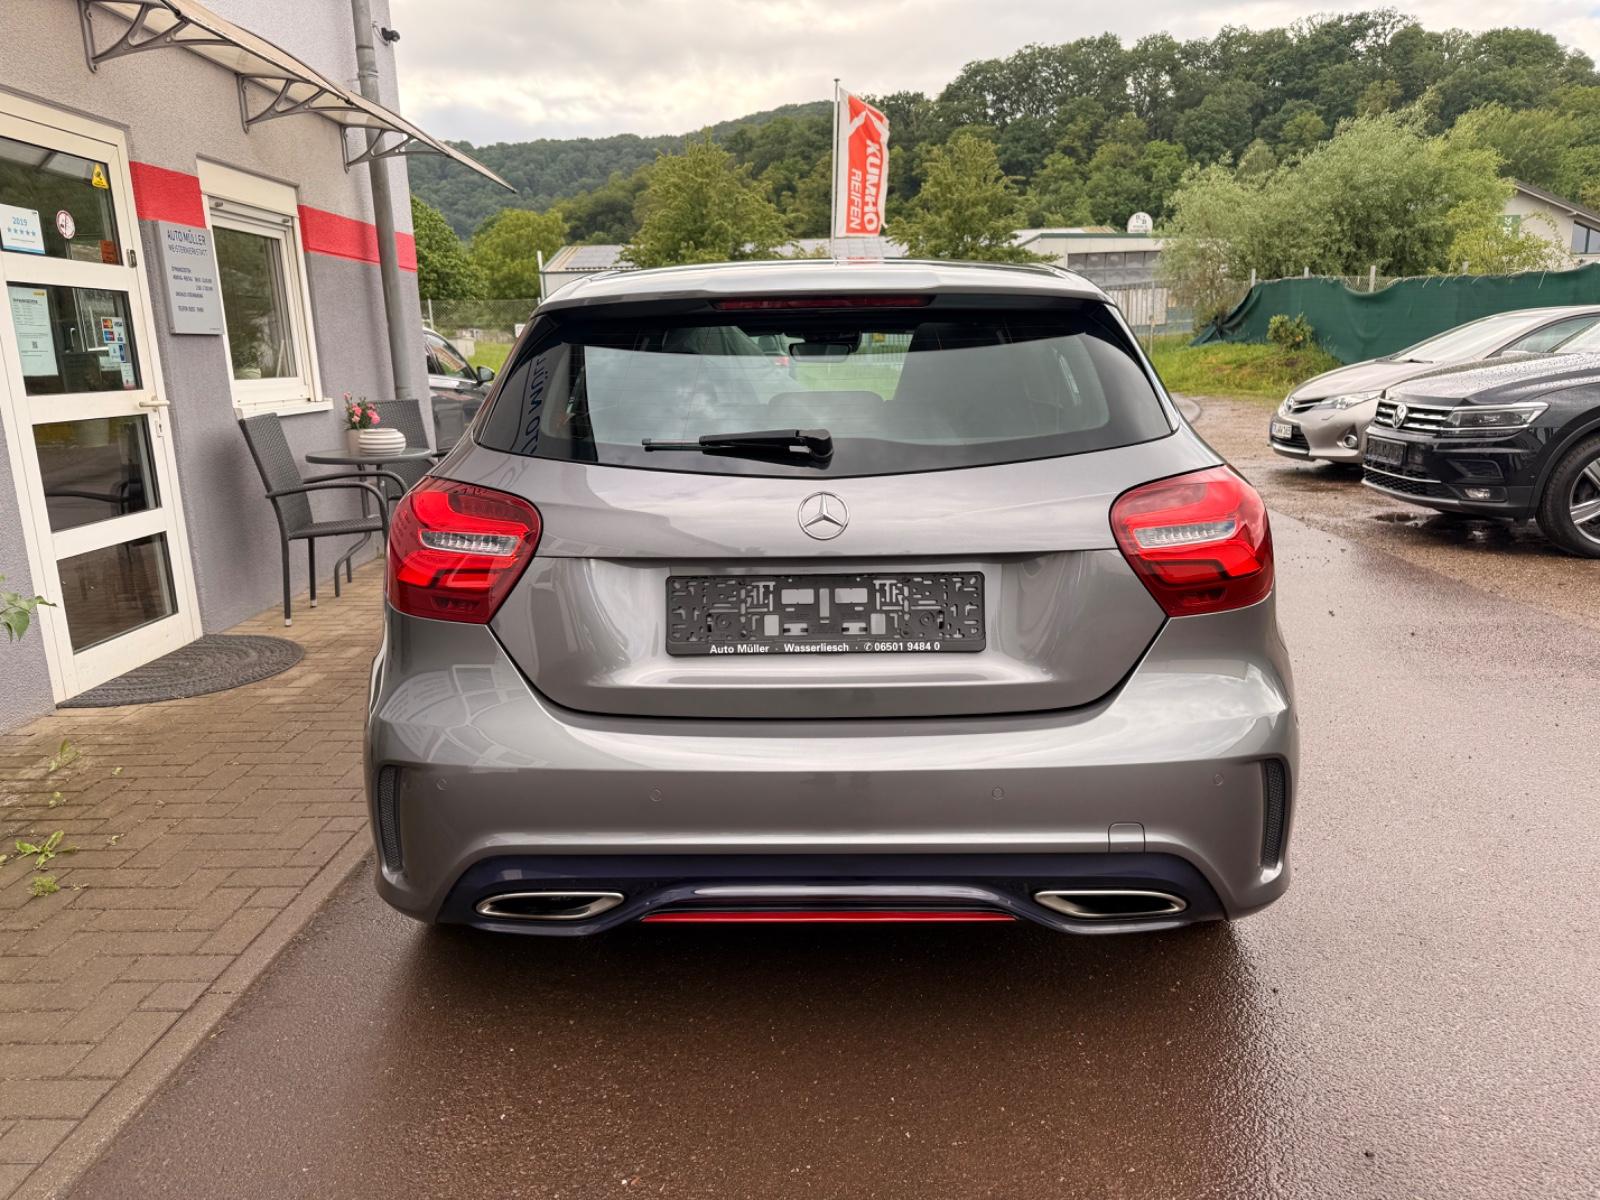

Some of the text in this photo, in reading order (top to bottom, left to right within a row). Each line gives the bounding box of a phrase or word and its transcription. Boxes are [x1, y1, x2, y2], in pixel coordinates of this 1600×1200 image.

[849, 168, 862, 229] REIFEN
[864, 139, 881, 231] KUMHO
[709, 641, 940, 654] Auto Müller Wasserliesch 06501 9484 0
